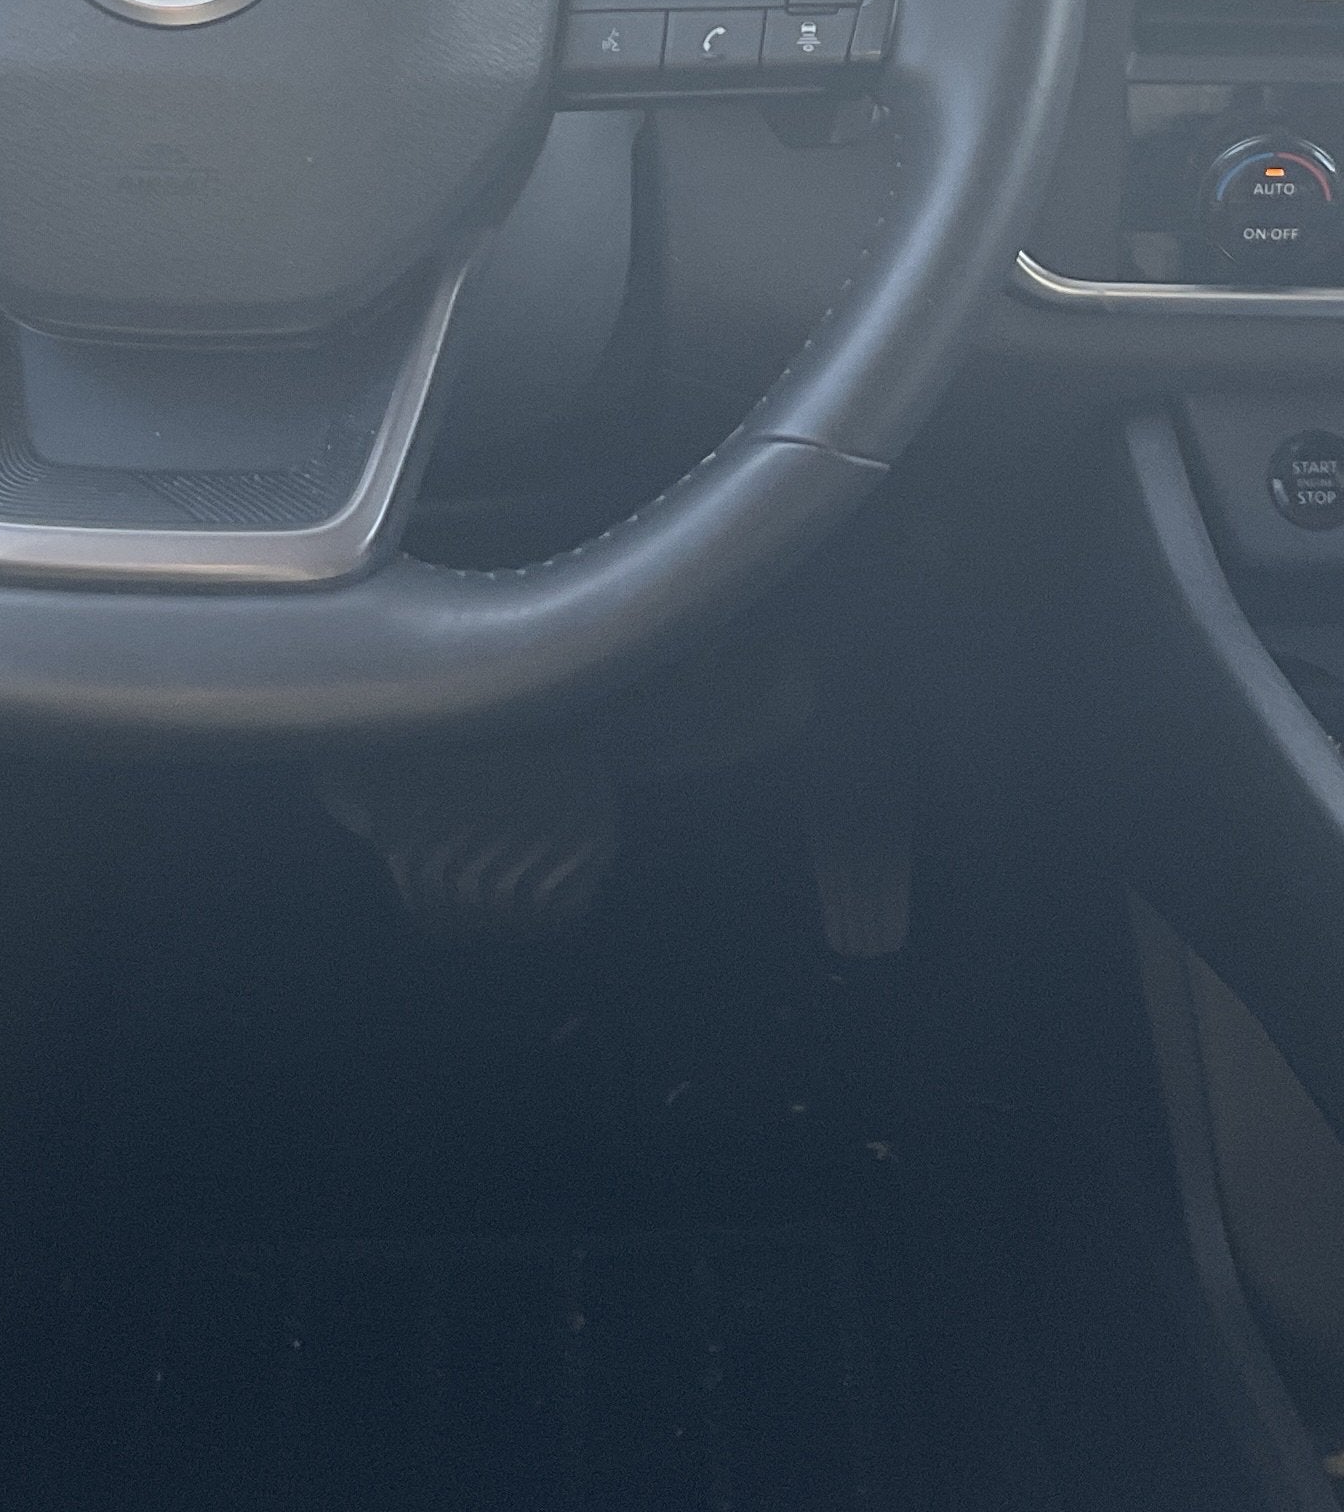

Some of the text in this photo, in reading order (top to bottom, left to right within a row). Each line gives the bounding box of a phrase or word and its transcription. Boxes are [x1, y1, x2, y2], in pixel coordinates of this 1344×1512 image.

[1253, 182, 1295, 196] AUTO
[1292, 460, 1336, 474] START
[1297, 490, 1337, 504] STOP
